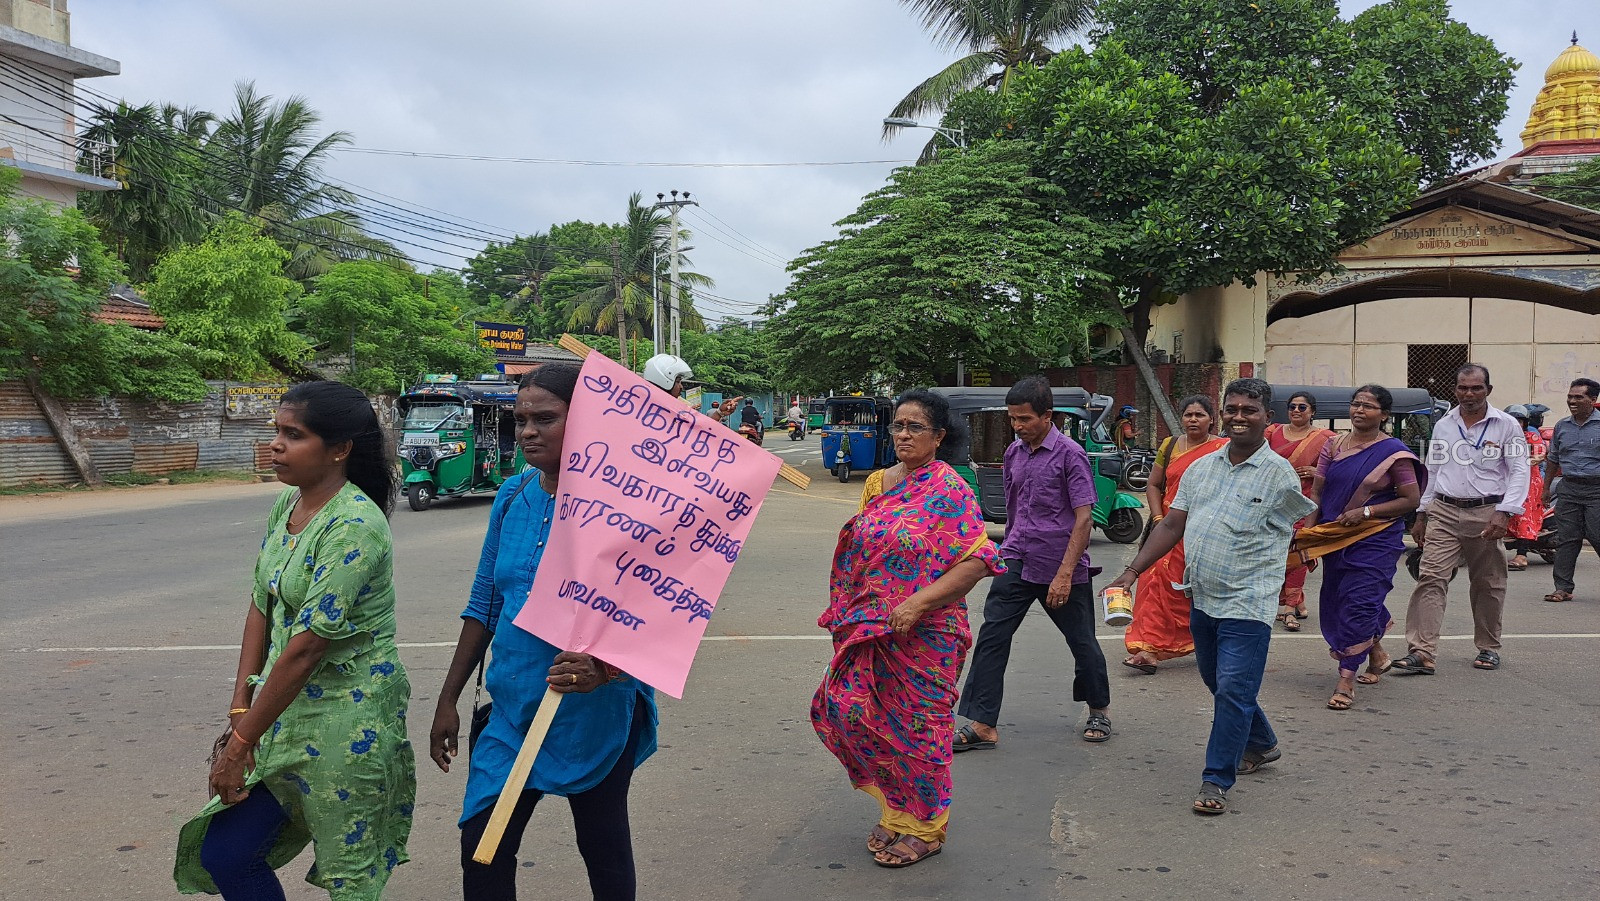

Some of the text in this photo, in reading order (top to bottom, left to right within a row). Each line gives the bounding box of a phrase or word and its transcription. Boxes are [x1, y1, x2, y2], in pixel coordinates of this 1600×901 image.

[491, 340, 510, 351] Drinking
[511, 341, 524, 350] Water
[500, 328, 525, 341] குடிநீர்
[583, 375, 740, 472] அதிகரித்த
[631, 437, 753, 522] இளவயது
[559, 493, 676, 556] காரணம்
[558, 579, 646, 631] பாவனை
